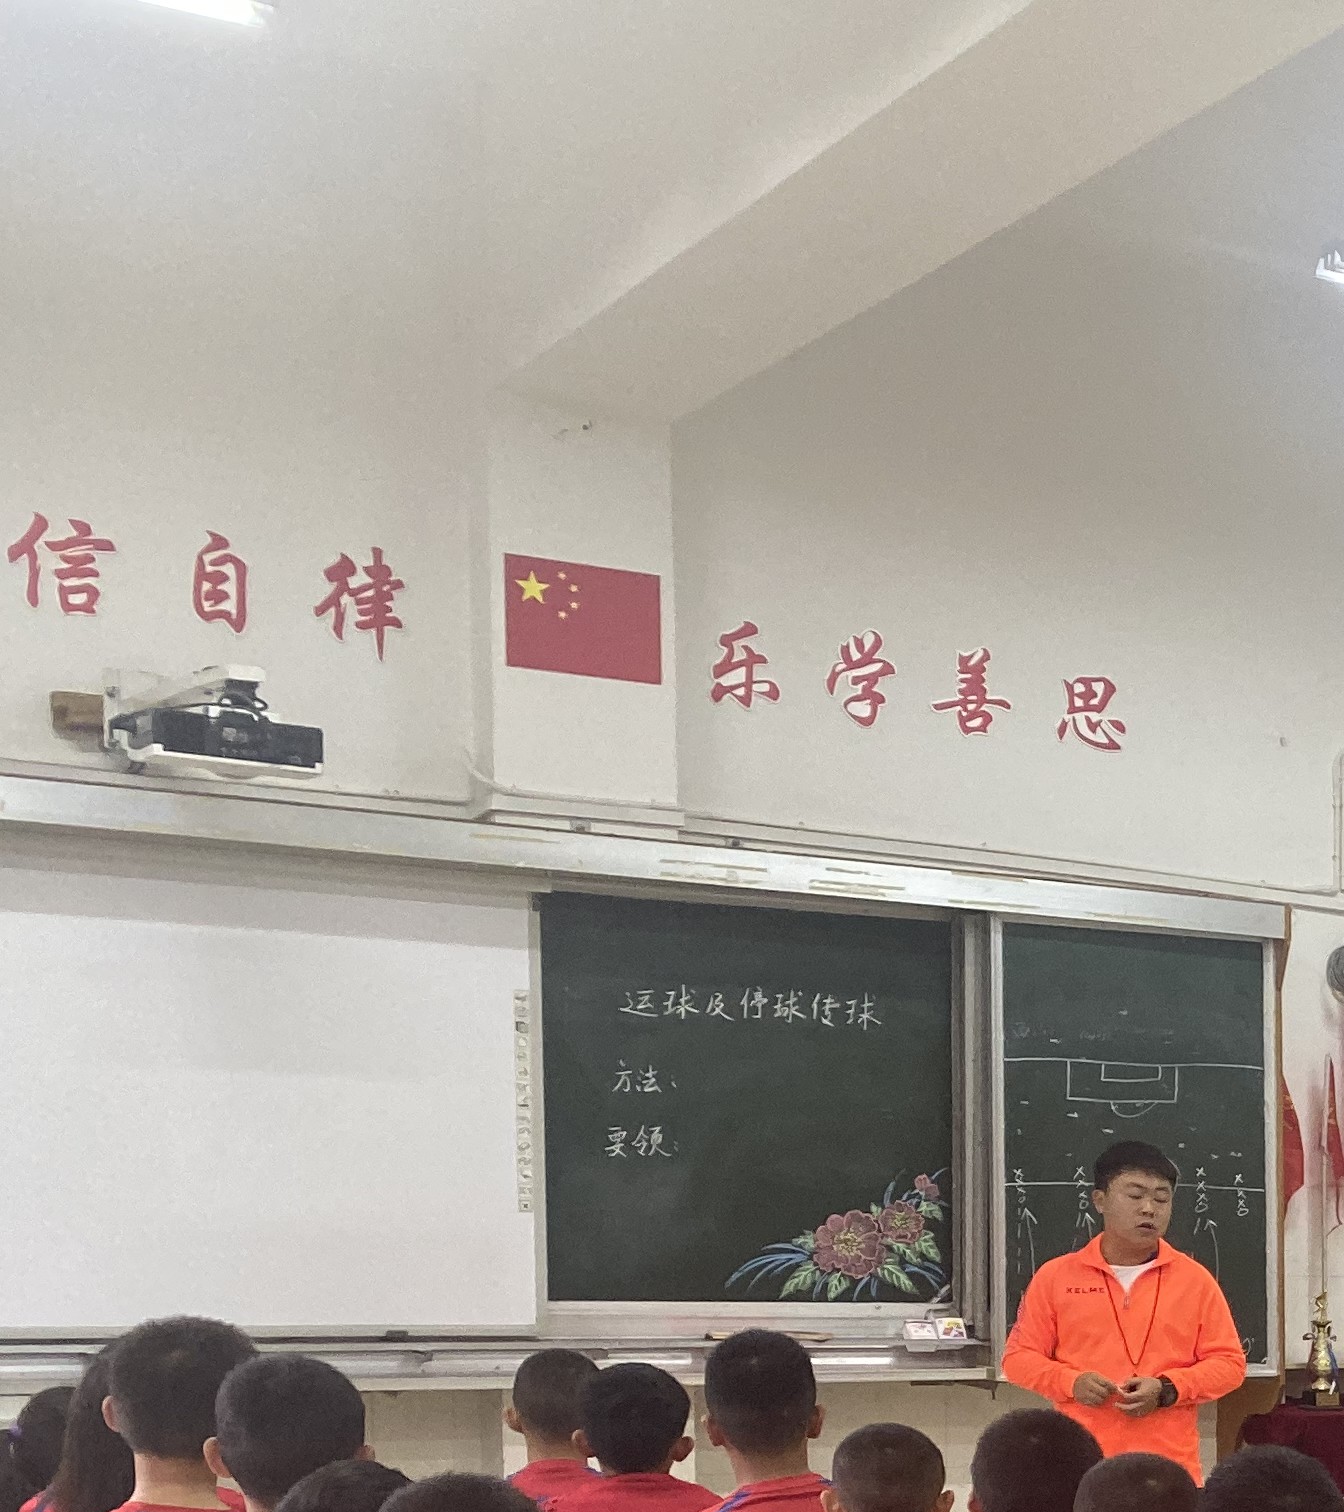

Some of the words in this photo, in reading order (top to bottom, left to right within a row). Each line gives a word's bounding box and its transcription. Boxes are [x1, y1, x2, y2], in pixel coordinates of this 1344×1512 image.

[7, 510, 405, 661] 信自律
[708, 620, 1127, 754] 乐学善思
[619, 983, 882, 1031] 运球及停球传球
